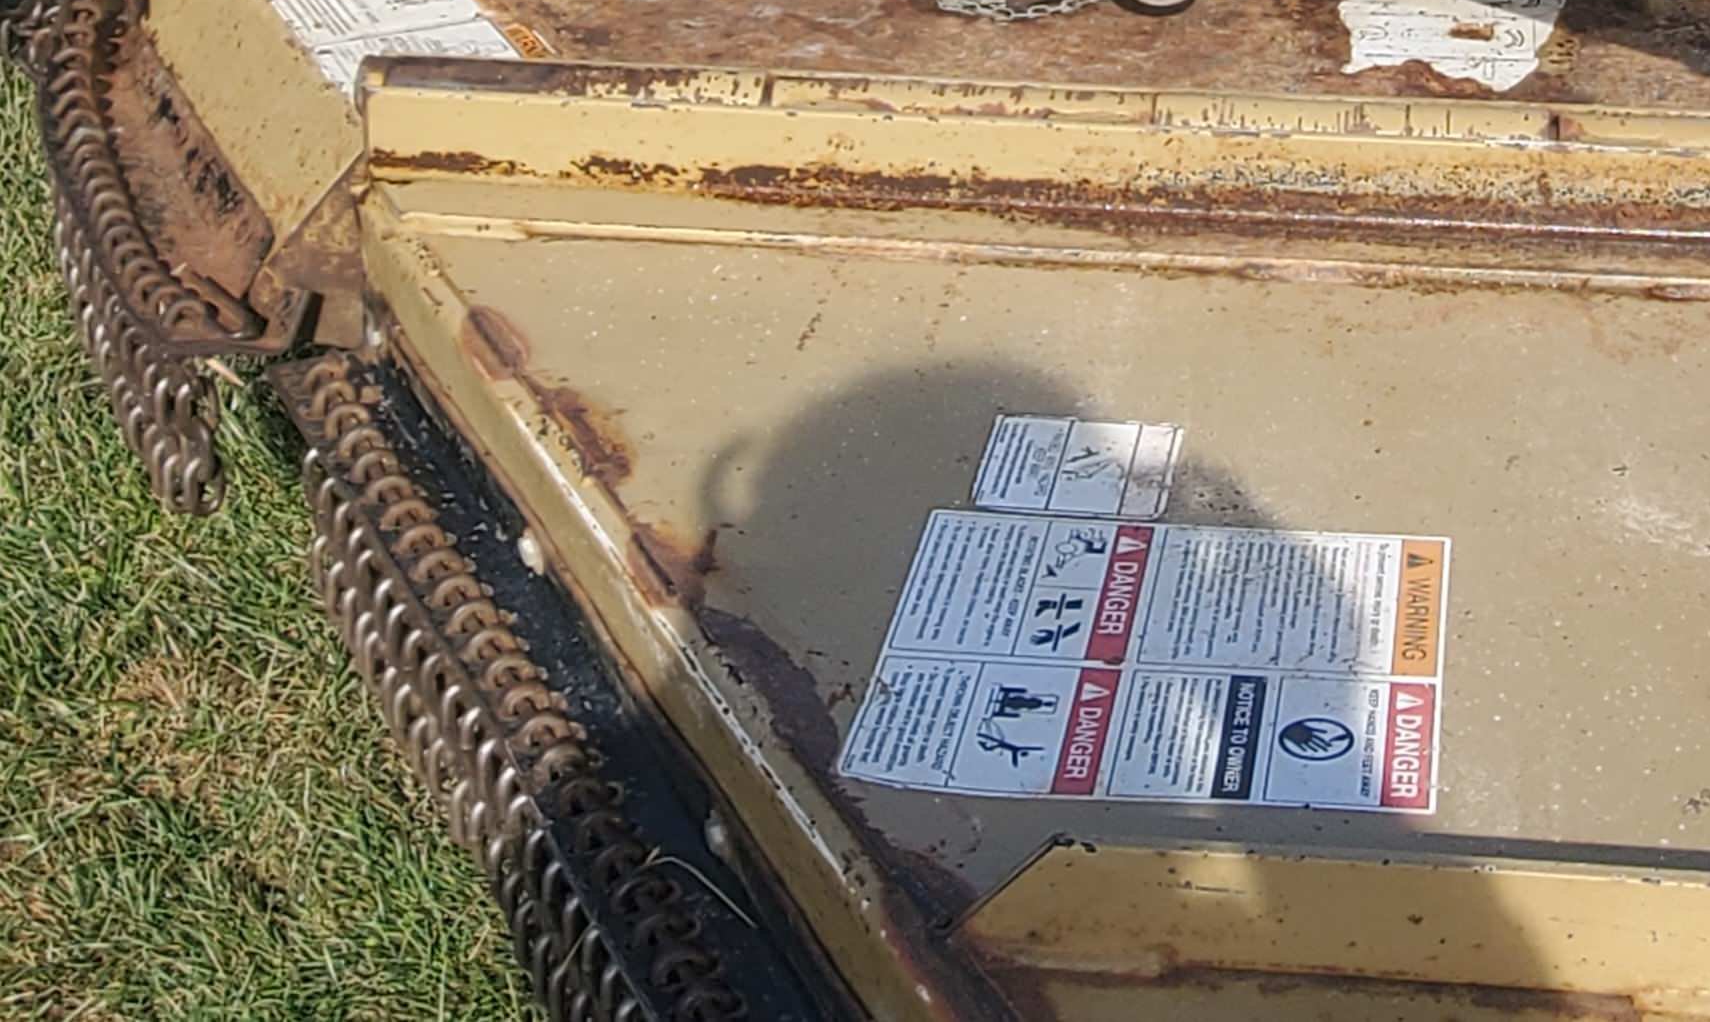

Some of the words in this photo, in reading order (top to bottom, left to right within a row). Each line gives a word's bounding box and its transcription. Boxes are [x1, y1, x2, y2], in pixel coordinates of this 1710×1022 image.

[1095, 561, 1139, 635] DANGER
[1401, 577, 1432, 661] WARNING
[1229, 728, 1248, 744] TO
[1232, 682, 1256, 725] NOTICE
[1062, 706, 1103, 779] DANGER
[1221, 746, 1246, 792] OWNER
[1388, 714, 1423, 798] DANGER
